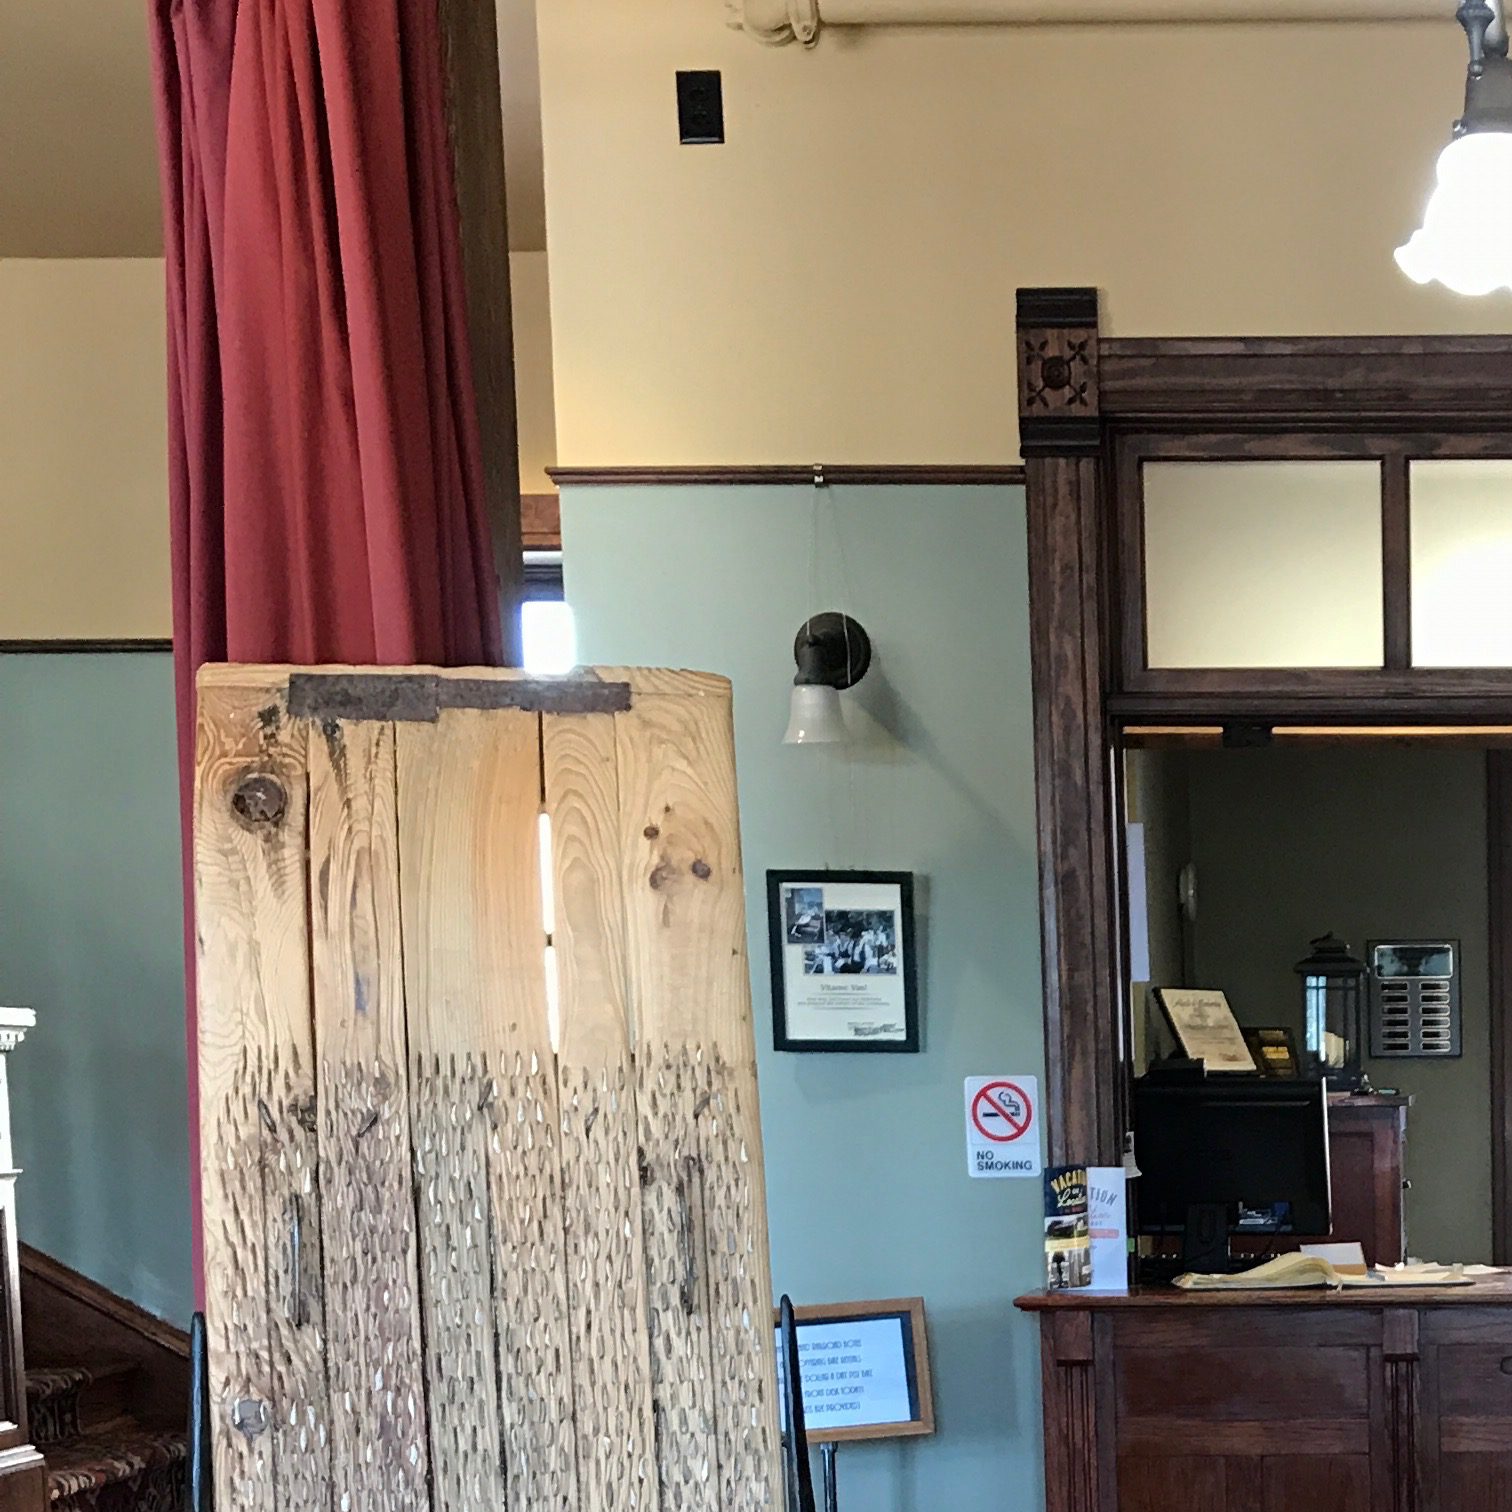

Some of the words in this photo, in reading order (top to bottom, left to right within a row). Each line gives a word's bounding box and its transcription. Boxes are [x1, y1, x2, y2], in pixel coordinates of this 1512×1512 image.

[976, 1150, 994, 1160] NO
[977, 1160, 1033, 1171] SMOKING
[1090, 1187, 1118, 1206] TION
